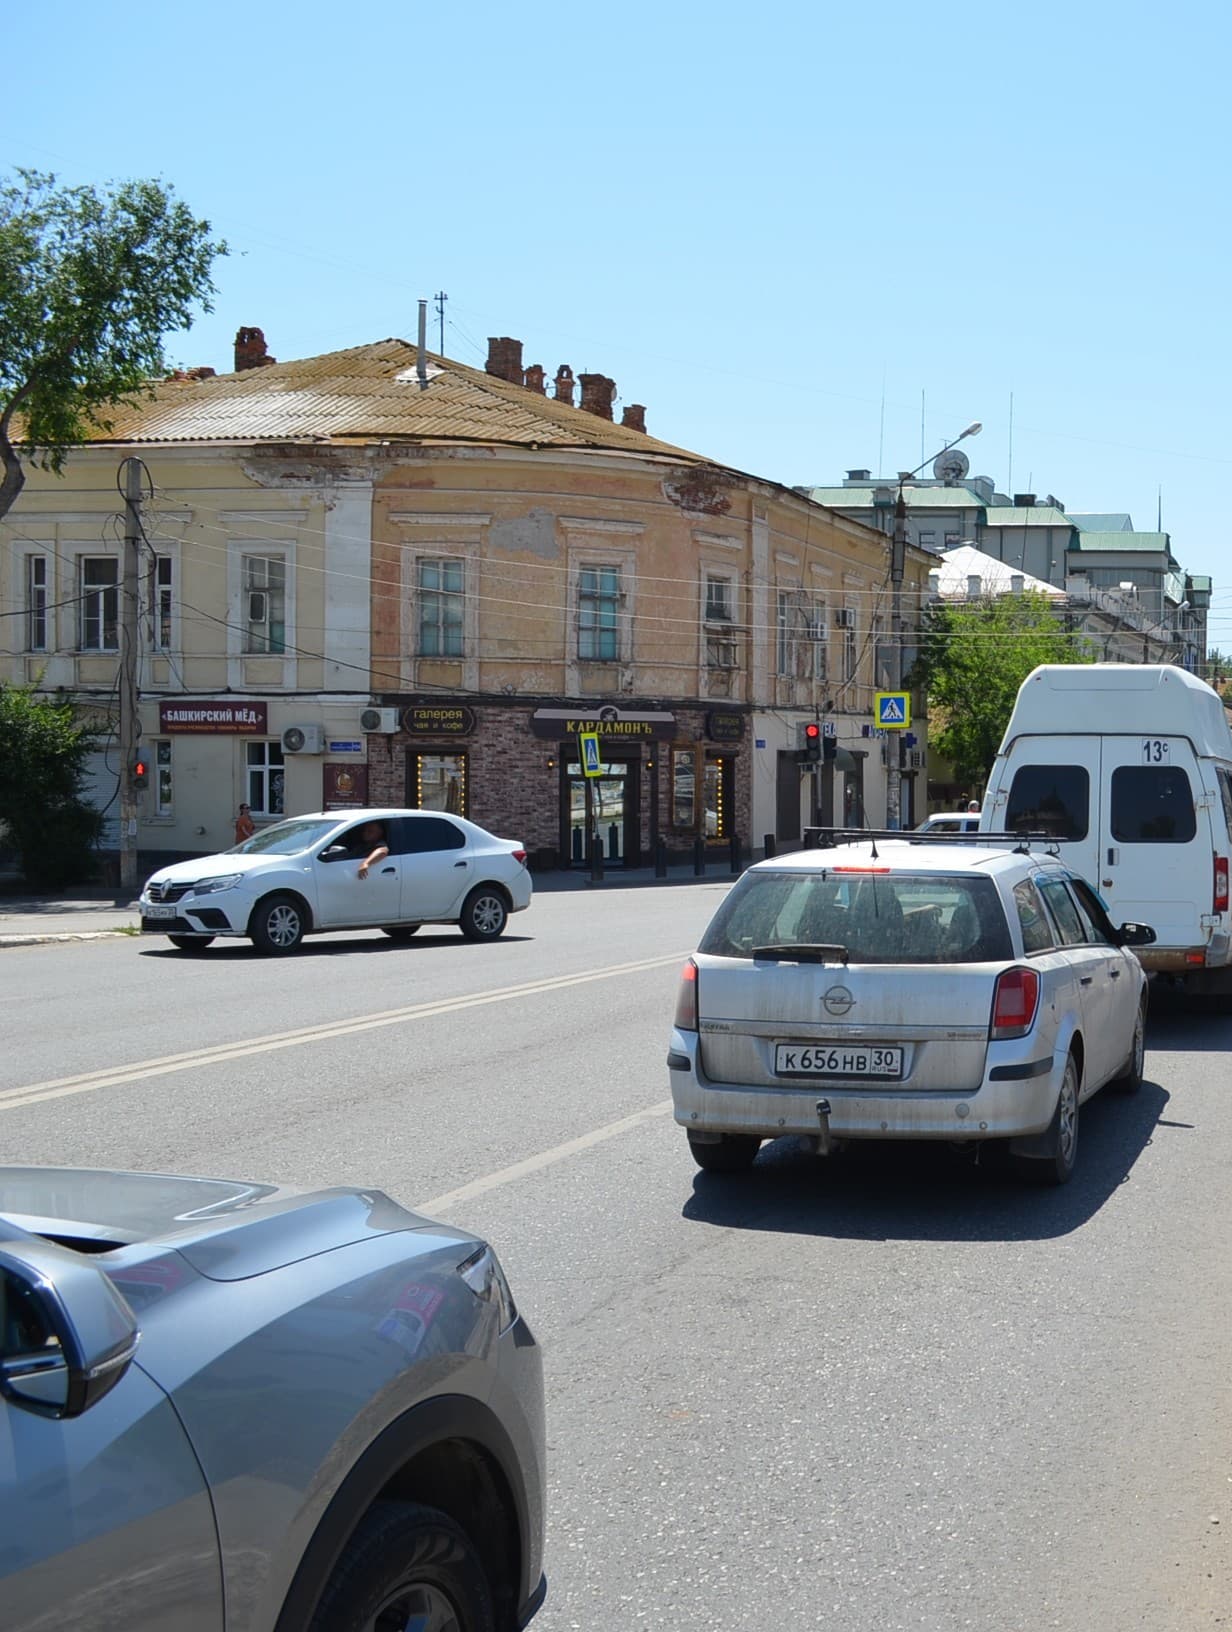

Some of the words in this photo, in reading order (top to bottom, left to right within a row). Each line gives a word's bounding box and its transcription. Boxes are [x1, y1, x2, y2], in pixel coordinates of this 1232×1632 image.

[414, 710, 463, 720] галерея
[566, 721, 652, 735] КАРДАМОНЪ
[874, 1051, 894, 1066] 30
